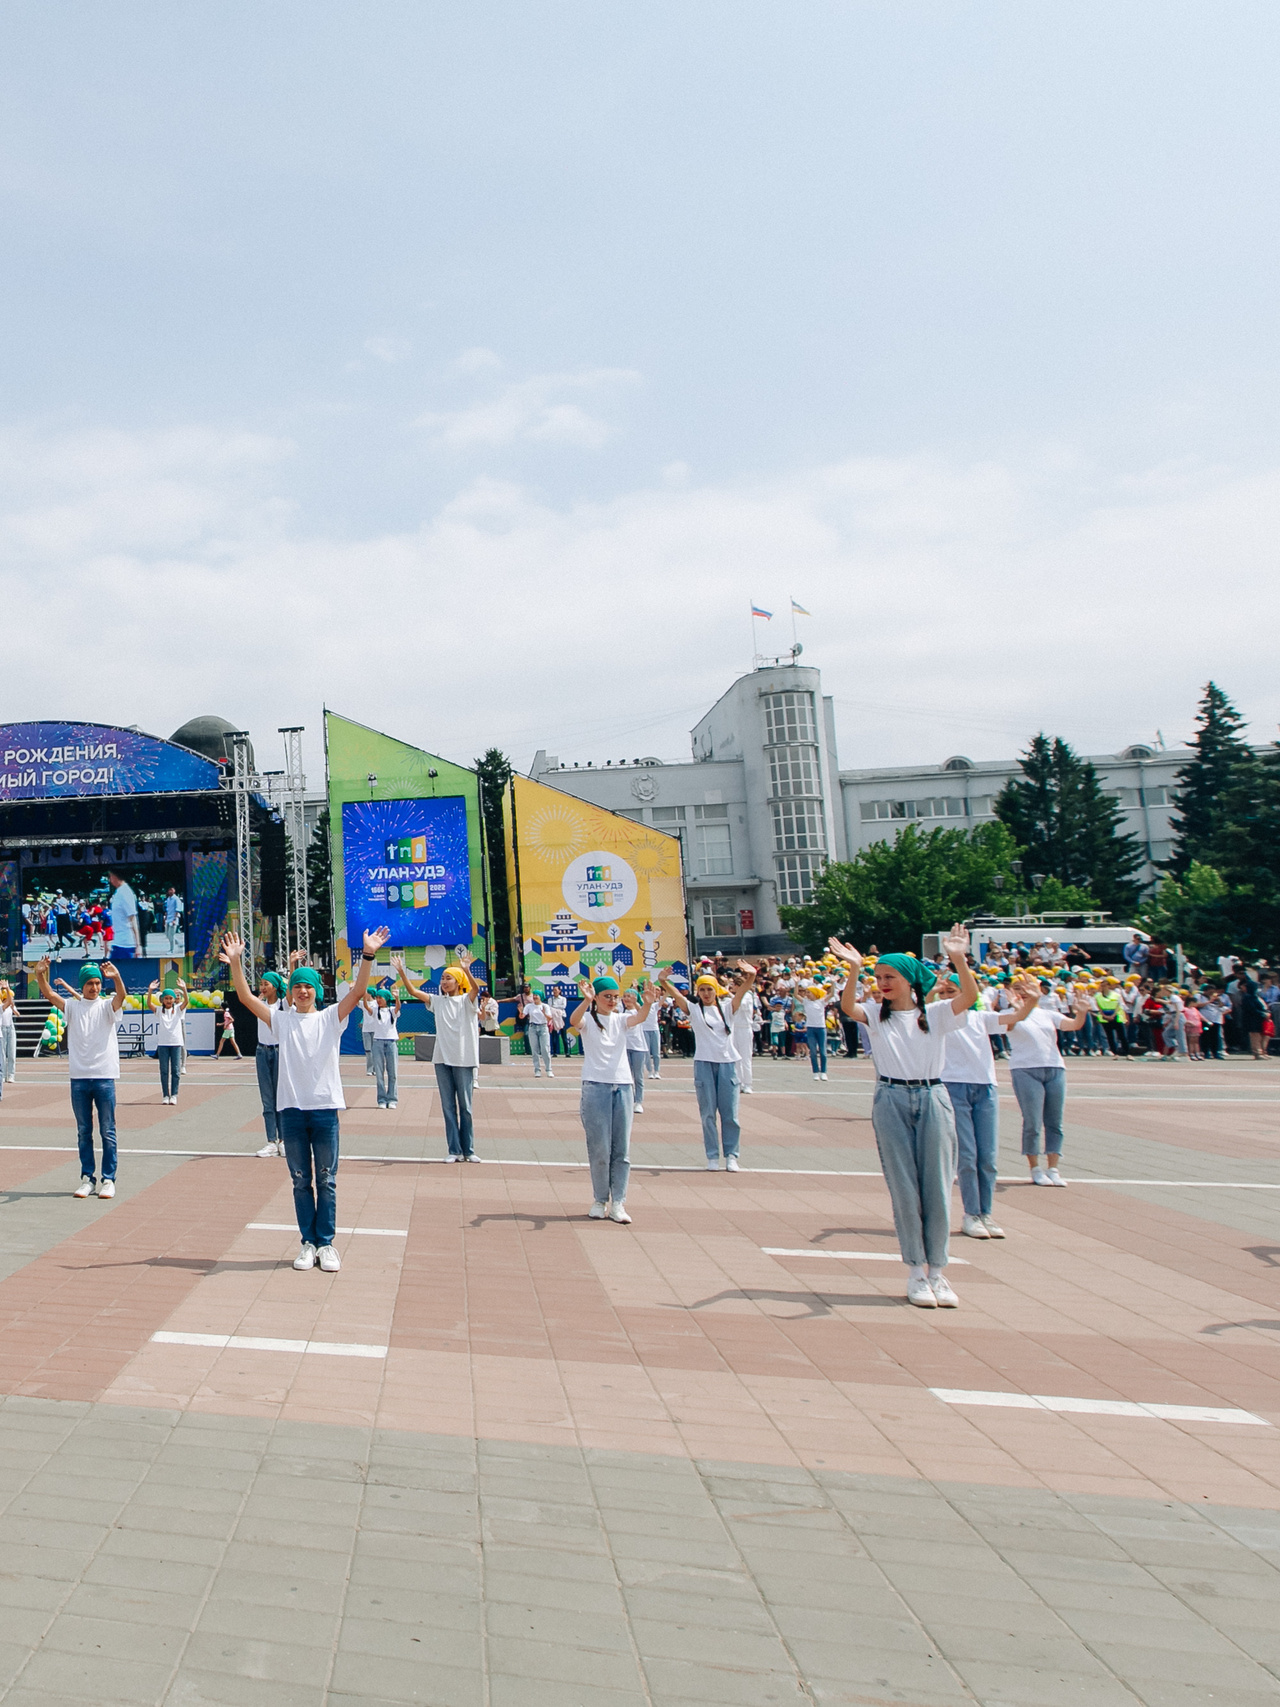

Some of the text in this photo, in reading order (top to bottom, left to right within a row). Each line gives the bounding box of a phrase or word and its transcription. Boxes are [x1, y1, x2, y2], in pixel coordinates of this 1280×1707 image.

[4, 743, 122, 765] РОЖДЕНИЯ,
[42, 767, 115, 786] ГОРОД!
[368, 865, 446, 880] УЛАН-УДЭ
[577, 882, 623, 890] УЛАН-УДЭ
